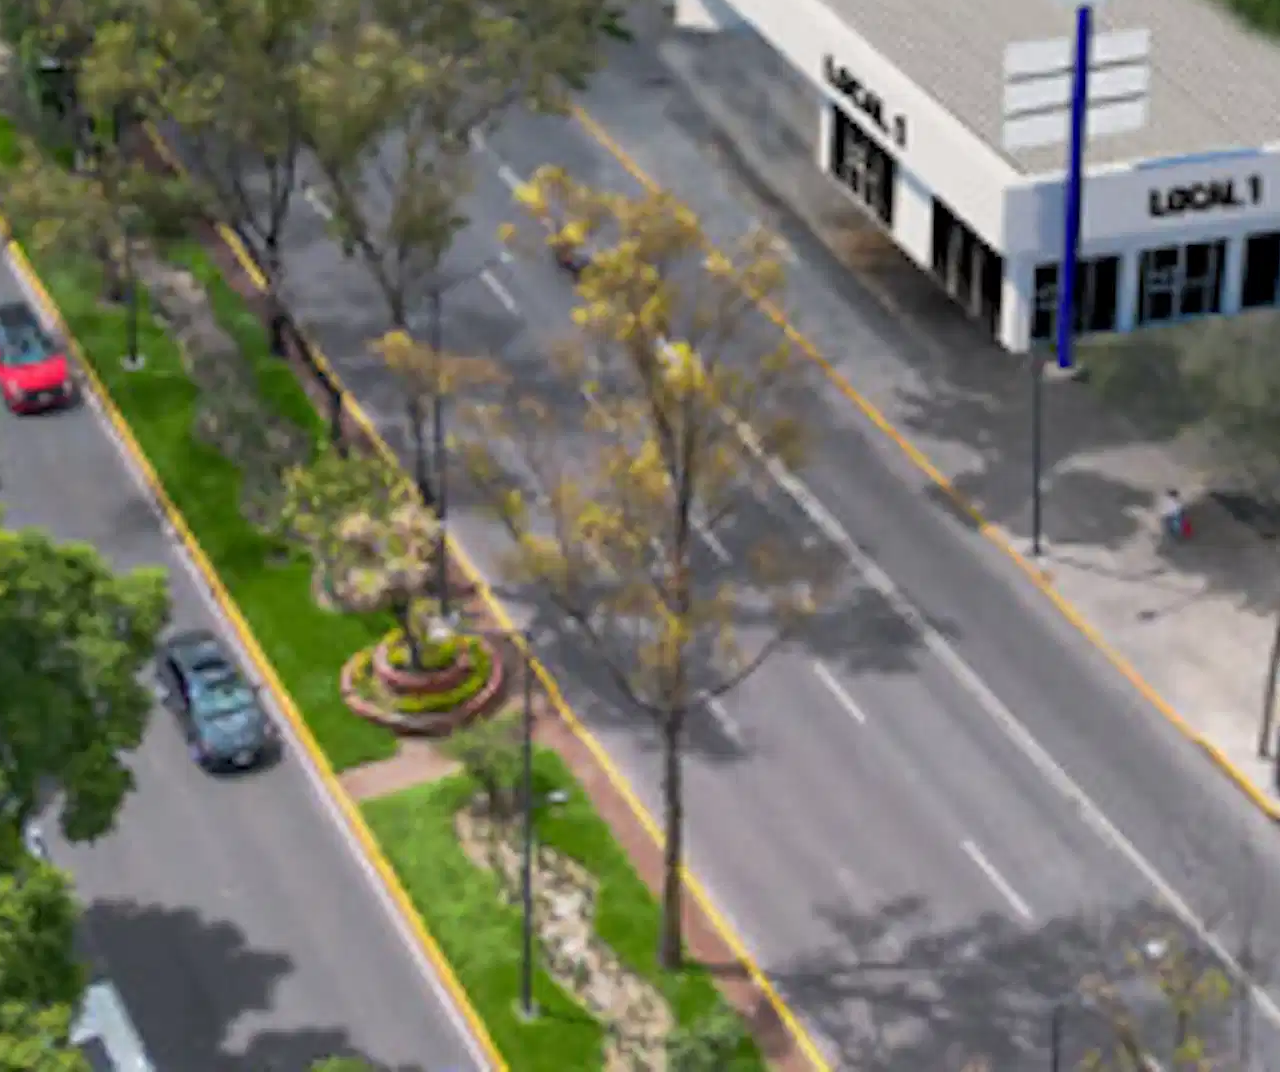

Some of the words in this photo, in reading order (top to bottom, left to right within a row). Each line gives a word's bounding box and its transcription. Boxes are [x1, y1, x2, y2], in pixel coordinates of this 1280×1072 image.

[822, 53, 890, 136] LOCAL
[893, 114, 908, 148] 1
[1148, 178, 1245, 218] LOCAL
[1246, 173, 1264, 207] 1
